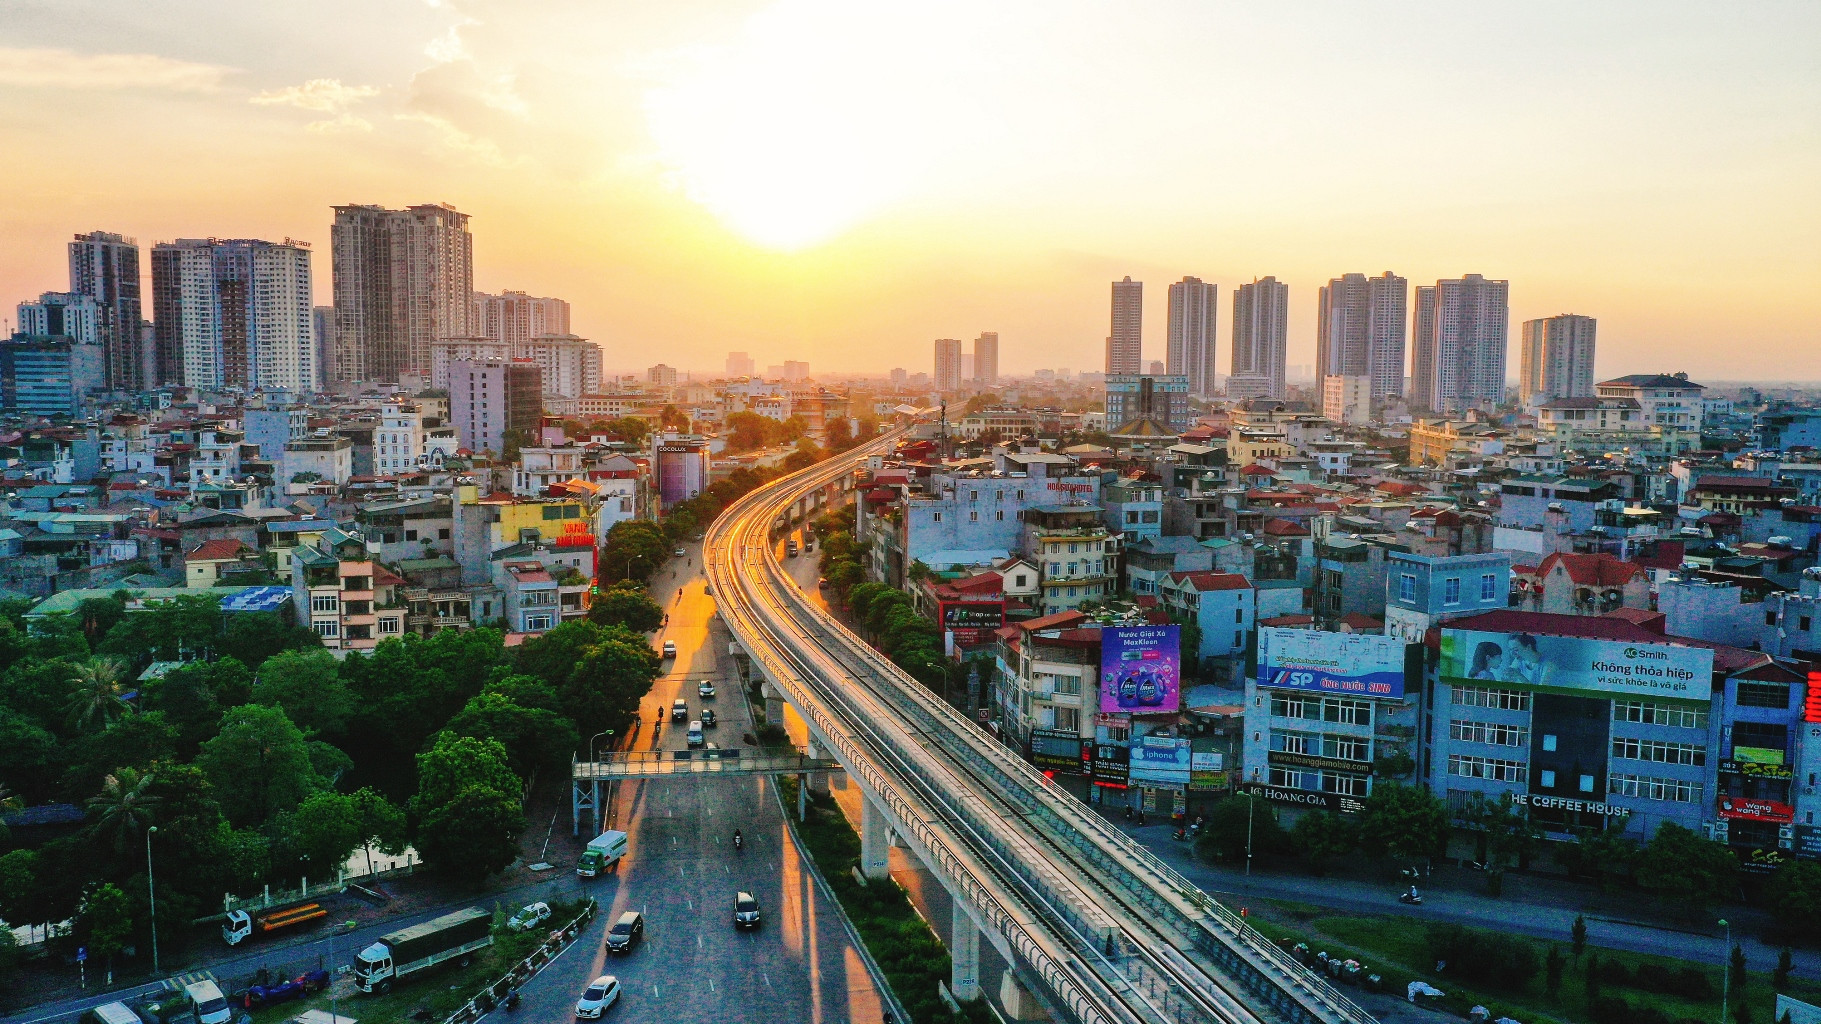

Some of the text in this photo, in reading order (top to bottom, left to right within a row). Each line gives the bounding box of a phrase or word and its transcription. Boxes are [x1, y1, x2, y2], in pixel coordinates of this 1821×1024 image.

[1638, 649, 1668, 660] Smith
[1592, 661, 1694, 681] Không thỏa hiệp
[1290, 672, 1314, 686] SP
[1320, 677, 1339, 689] ỐNG
[1608, 676, 1624, 685] sức
[1626, 677, 1648, 687] khỏe
[1650, 679, 1658, 688] là
[1673, 682, 1687, 691] giá
[1146, 750, 1173, 759] iphone
[1272, 753, 1369, 772] www.hoanggiamobile.com
[1265, 788, 1305, 803] HOANG
[1306, 794, 1327, 806] GIA
[1532, 796, 1582, 812] COFFEE
[1586, 802, 1630, 817] HOUSE
[1736, 808, 1760, 816] wang
[1745, 802, 1772, 813] Wang
